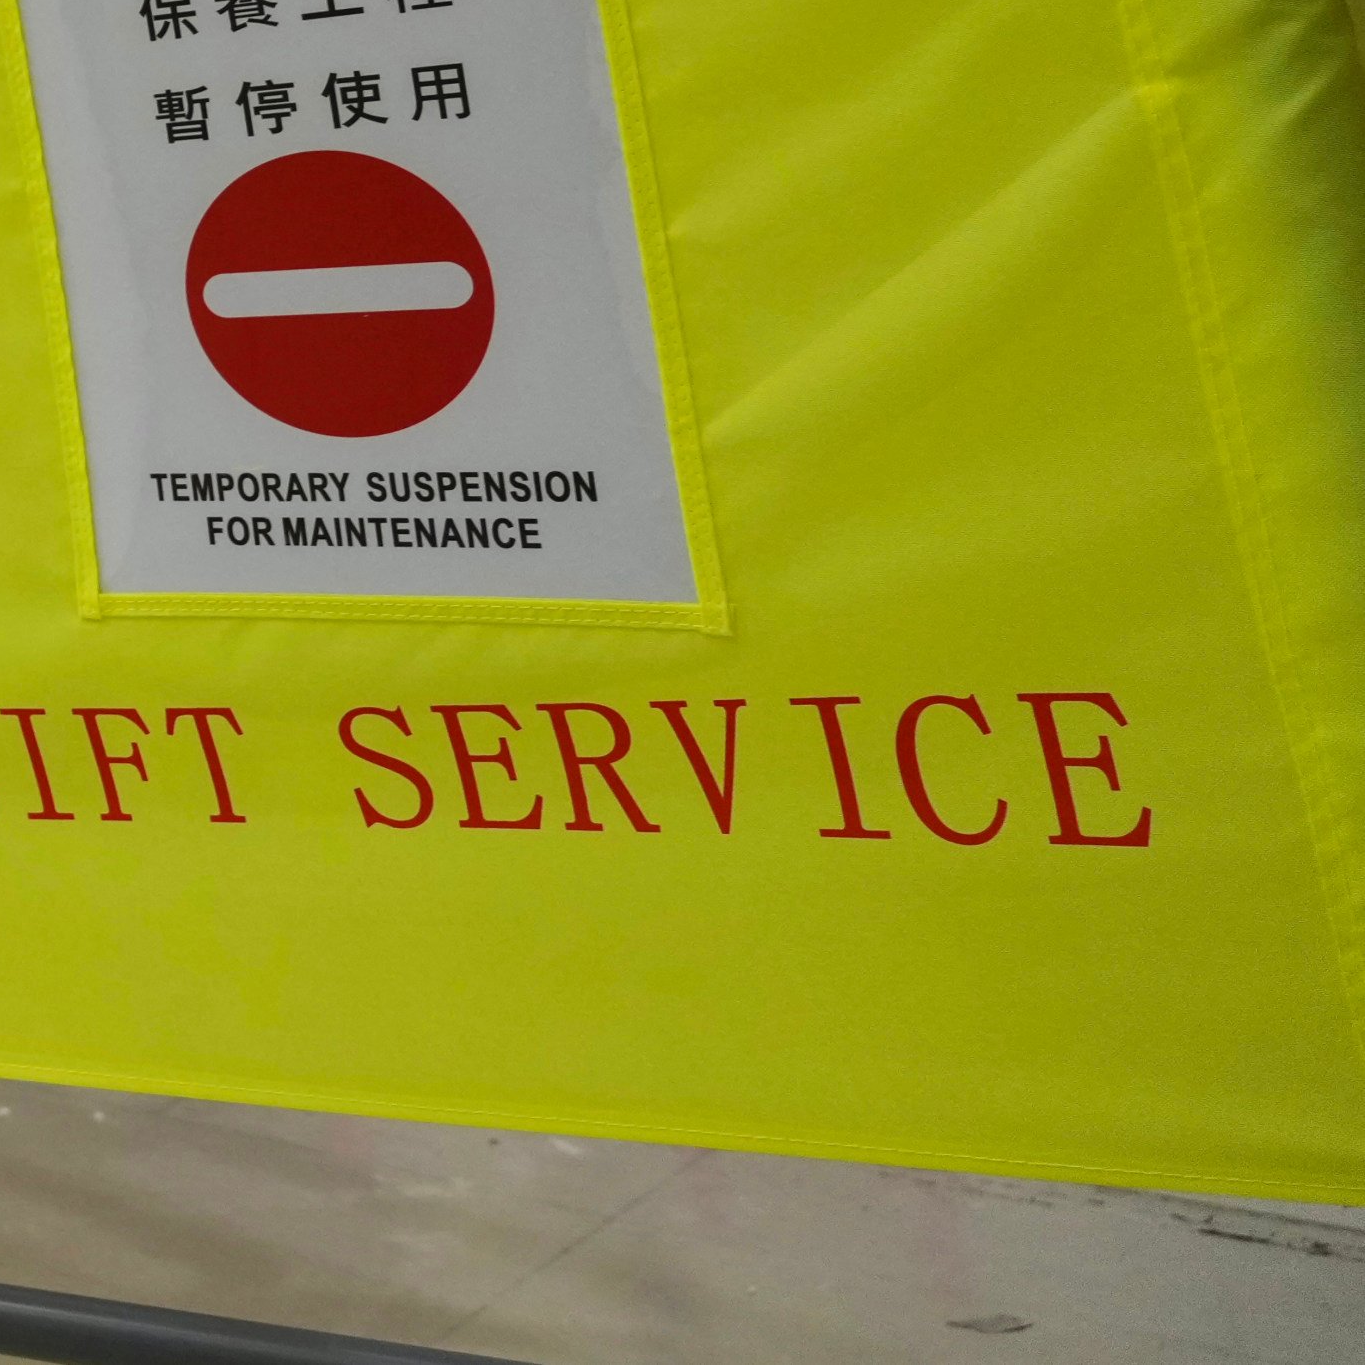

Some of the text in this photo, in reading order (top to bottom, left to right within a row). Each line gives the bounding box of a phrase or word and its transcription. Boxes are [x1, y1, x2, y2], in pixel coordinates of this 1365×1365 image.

[153, 62, 471, 144] 暫停使用
[150, 470, 598, 502] TEMPORARY SUSPENSION
[206, 516, 543, 549] FOR MAINTENANCE
[337, 691, 1153, 849] SERVICE
